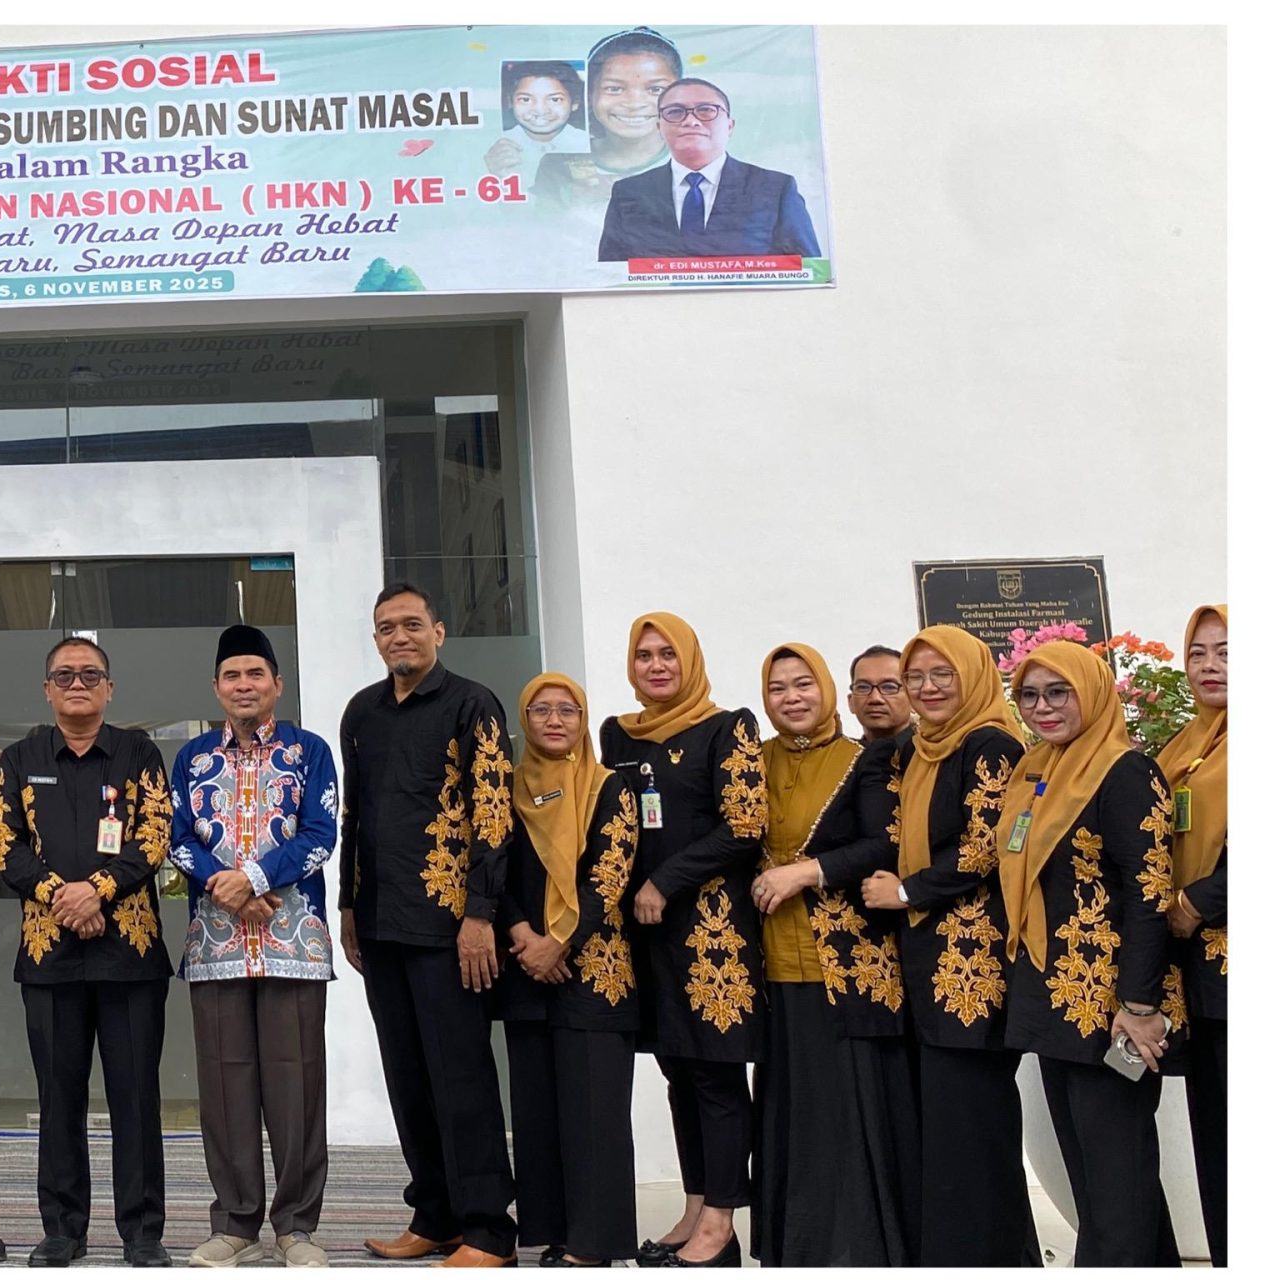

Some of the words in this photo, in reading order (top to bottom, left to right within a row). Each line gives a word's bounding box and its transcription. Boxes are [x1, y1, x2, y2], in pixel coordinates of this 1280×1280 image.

[86, 53, 276, 91] SOSIAL
[159, 103, 227, 139] DAN
[237, 97, 349, 134] SUNAT
[359, 91, 479, 129] MASAL
[102, 145, 249, 178] Rangka
[31, 186, 223, 218] NASIONAL
[266, 181, 348, 210] HKN
[393, 178, 444, 205] KE
[477, 175, 526, 203] 61
[53, 222, 159, 246] Masa
[172, 217, 284, 247] Depan
[295, 212, 399, 236] Hebat
[73, 248, 250, 273] Semangat
[260, 241, 350, 264] Baru
[24, 283, 37, 297] 6
[42, 279, 163, 296] NOVEMBER
[169, 276, 224, 292] 2025
[962, 611, 994, 620] Gedung
[995, 610, 1030, 618] Instalasi
[1031, 609, 1065, 617] Farmasi
[967, 620, 988, 628] Sakit
[989, 620, 1017, 628] Umum
